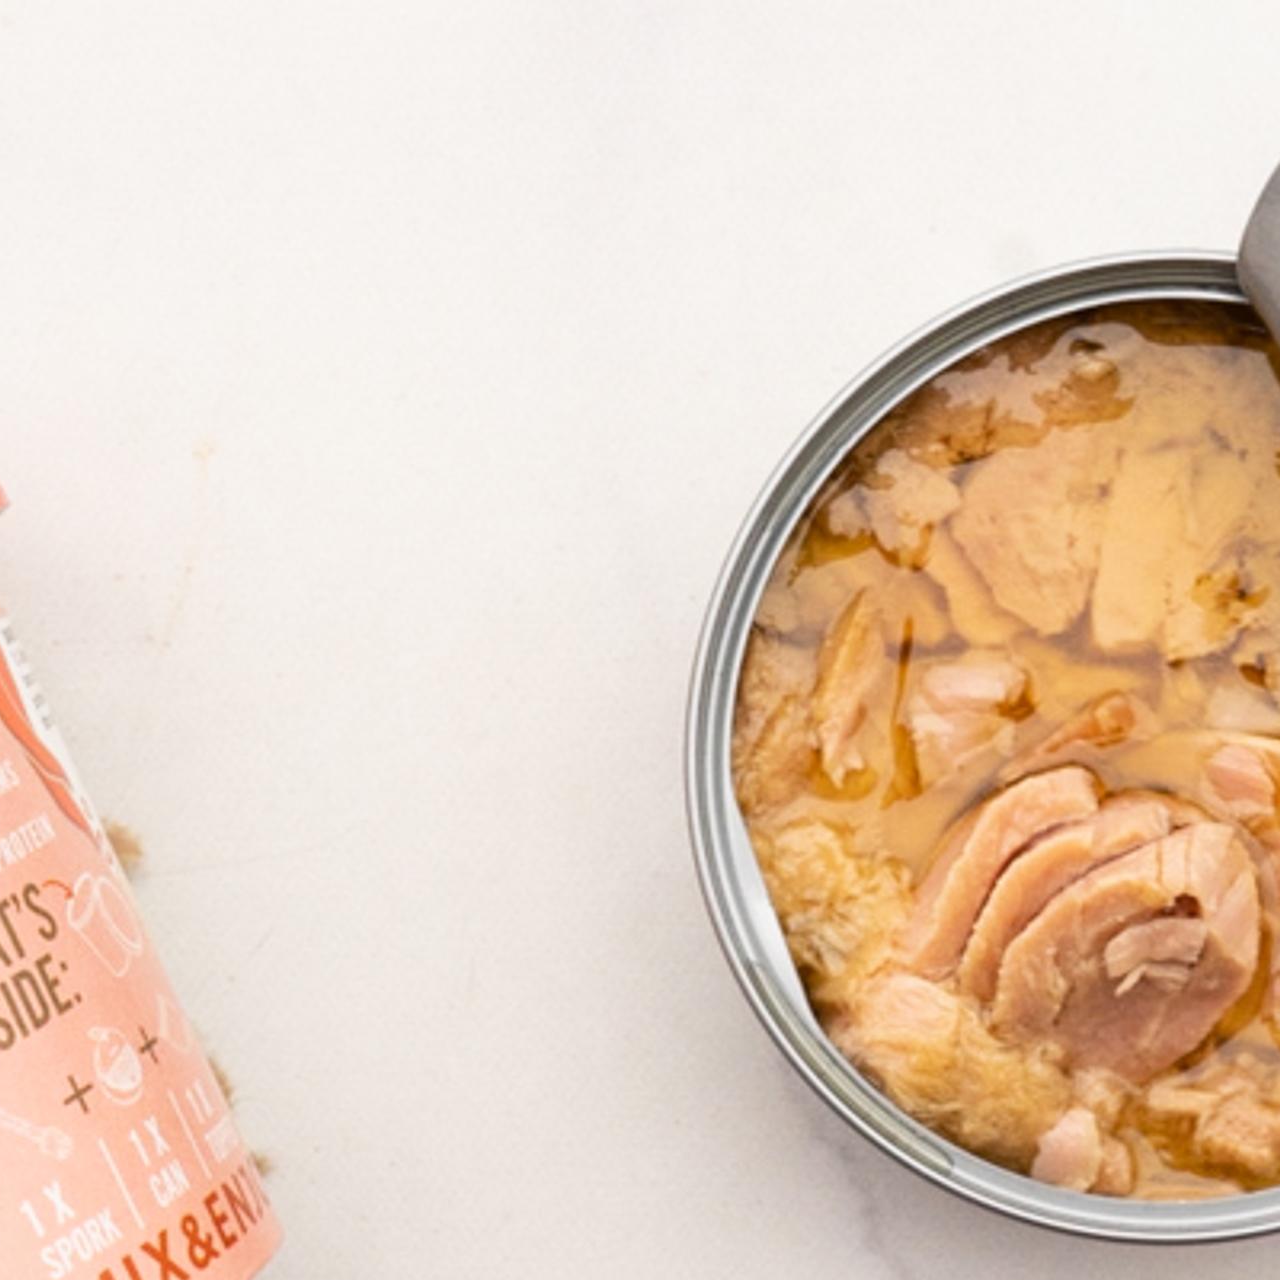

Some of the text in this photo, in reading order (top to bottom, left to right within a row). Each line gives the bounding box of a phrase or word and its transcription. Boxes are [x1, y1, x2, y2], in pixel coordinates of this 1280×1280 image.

[128, 1127, 151, 1168] 1
[143, 1114, 171, 1158] X
[19, 1176, 76, 1239] 1 X
[148, 1157, 192, 1209] CAN
[39, 1206, 124, 1280] SPORK
